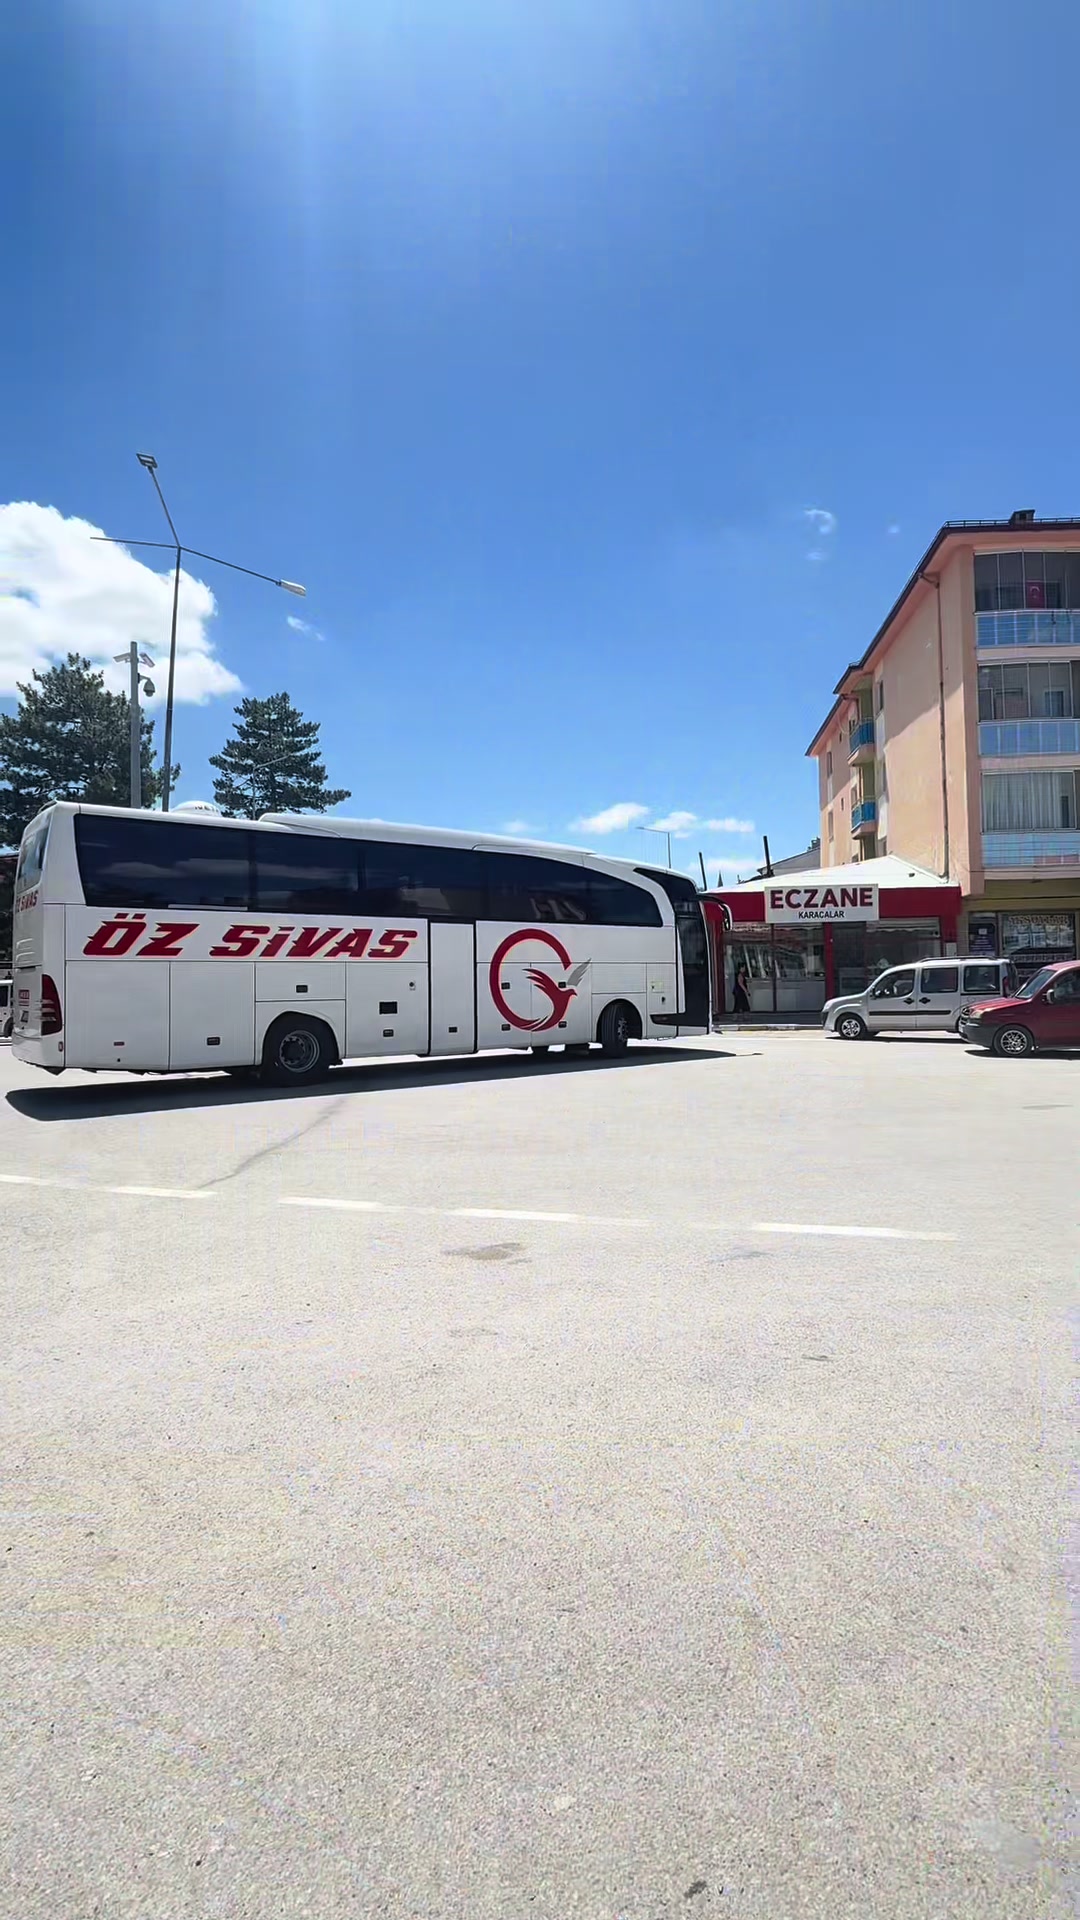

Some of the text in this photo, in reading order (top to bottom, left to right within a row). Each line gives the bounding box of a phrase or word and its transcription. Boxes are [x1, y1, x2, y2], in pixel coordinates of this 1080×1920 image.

[770, 887, 873, 909] ECZANE
[798, 910, 845, 919] KARACALAR
[82, 912, 200, 957] ÖZ
